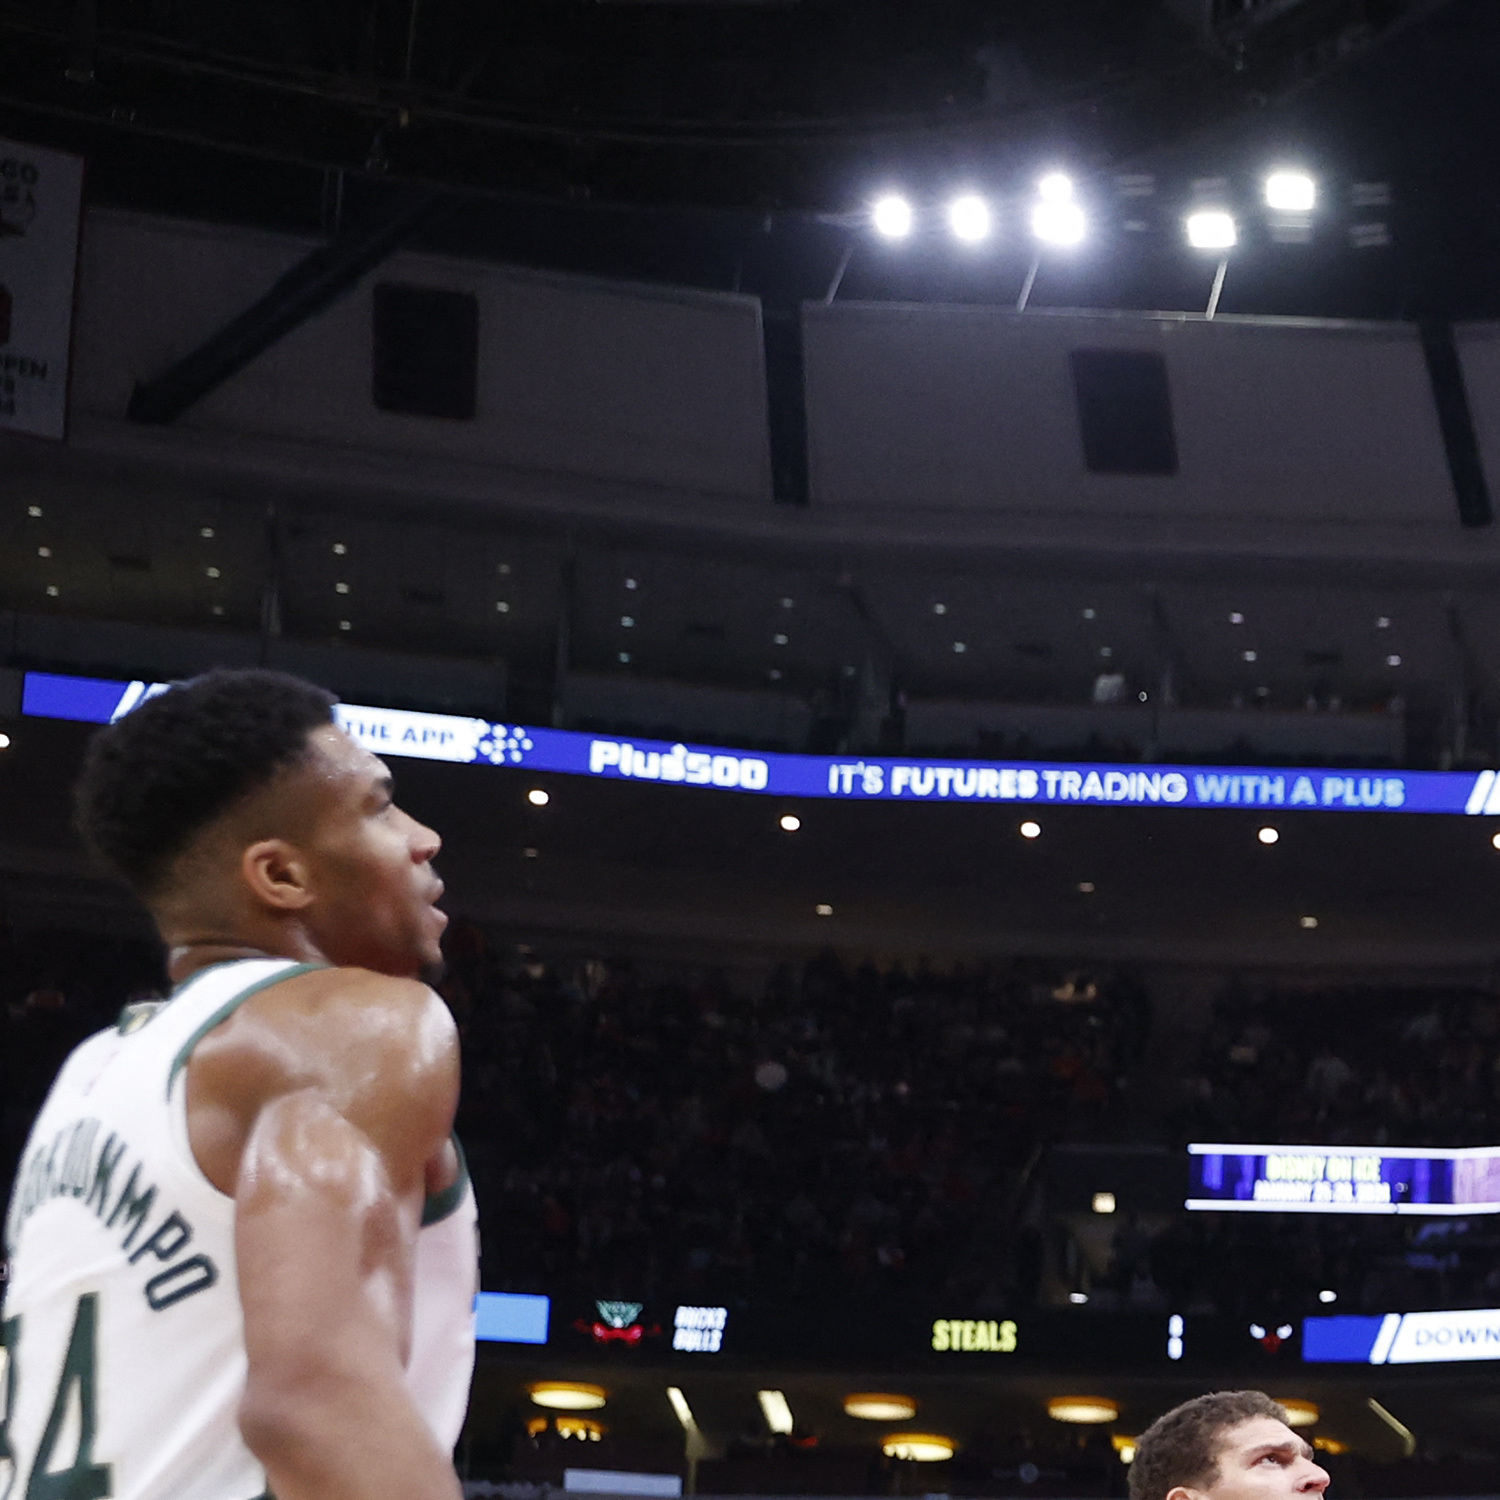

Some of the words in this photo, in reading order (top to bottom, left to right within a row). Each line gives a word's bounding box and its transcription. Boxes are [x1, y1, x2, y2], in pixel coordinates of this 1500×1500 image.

[345, 719, 393, 746] THE
[401, 725, 456, 748] APP
[590, 739, 769, 791] Plus500
[829, 761, 885, 795] IT'S
[891, 764, 1038, 799] FUTURES
[1043, 770, 1189, 802] TRADING
[1194, 772, 1286, 805] WITH
[1288, 776, 1319, 807] A
[1323, 777, 1405, 808] PLUS
[932, 1319, 1018, 1353] STEALS
